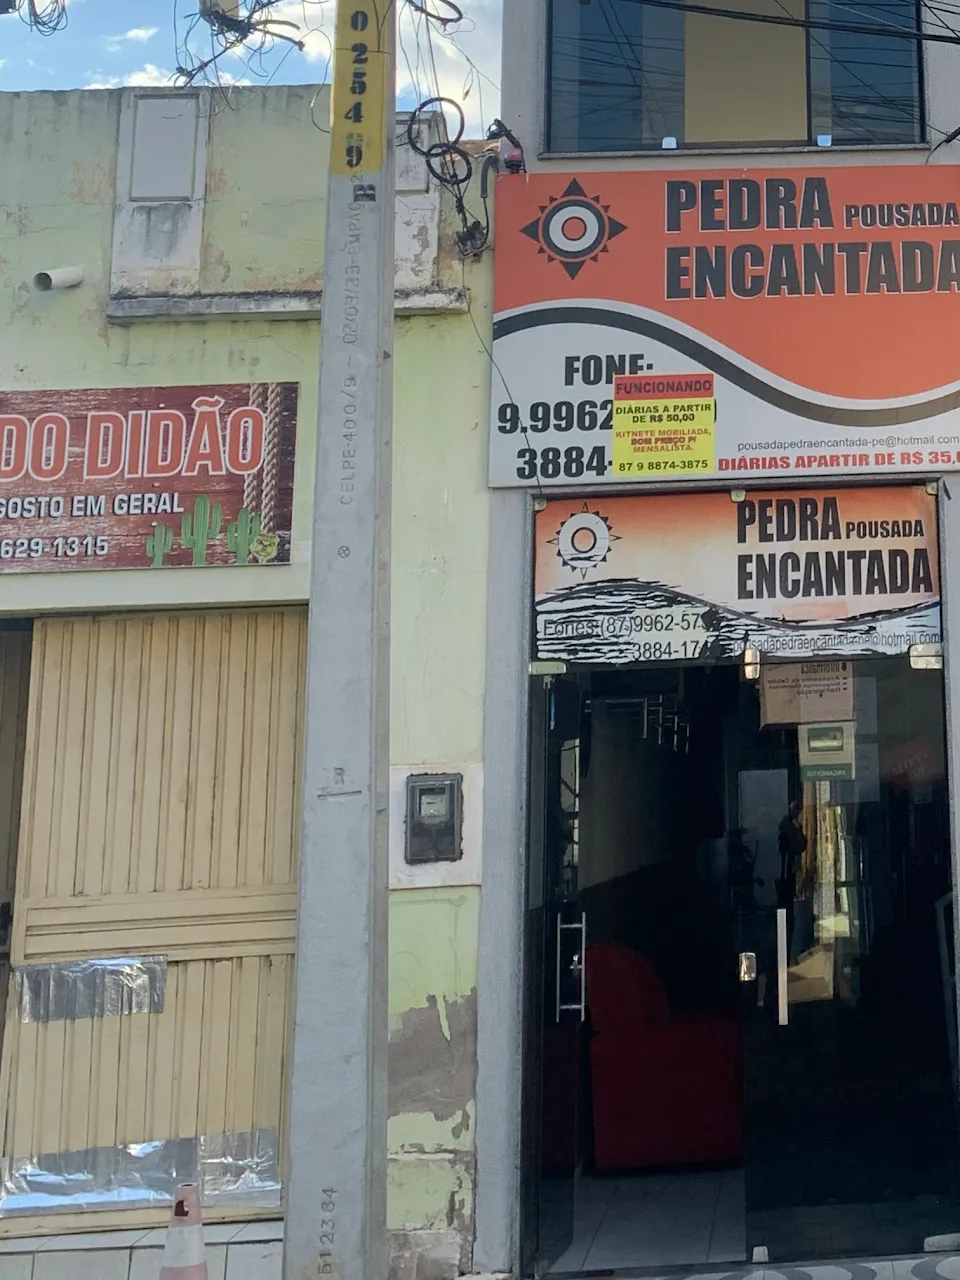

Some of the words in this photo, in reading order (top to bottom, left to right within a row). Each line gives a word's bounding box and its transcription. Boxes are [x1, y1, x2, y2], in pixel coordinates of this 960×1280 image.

[665, 177, 834, 233] PEDRA
[844, 202, 960, 229] POUSADA
[616, 380, 713, 395] FUNCIONANDO
[498, 400, 613, 434] 9.9962
[616, 405, 659, 415] DIÁRIAS
[663, 405, 670, 413] A
[673, 404, 711, 413] PARTIR
[632, 415, 646, 423] DE
[650, 414, 663, 423] R$
[667, 413, 695, 423] 50,00
[84, 395, 267, 480] DIDÃO
[616, 430, 656, 438] KITNETE
[658, 428, 711, 437] MOBILIADA,
[737, 435, 960, 452] pousadapedraencantada-pe@hotmail.com
[516, 446, 613, 480] 3884-
[619, 463, 633, 471] 87
[636, 462, 644, 471] 9
[647, 460, 709, 470] 8874-3875
[718, 454, 791, 471] DIÁRIAS
[795, 452, 870, 469] APARTIR
[874, 452, 895, 466] DE
[900, 451, 924, 466] R$
[72, 495, 106, 517] EM
[114, 492, 185, 515] GERAL
[737, 496, 841, 543] PEDRA
[845, 519, 925, 539] POUSADA
[0, 536, 109, 559] 629-1315
[737, 548, 934, 600] ENCANTADA
[632, 640, 701, 660] 3884-17
